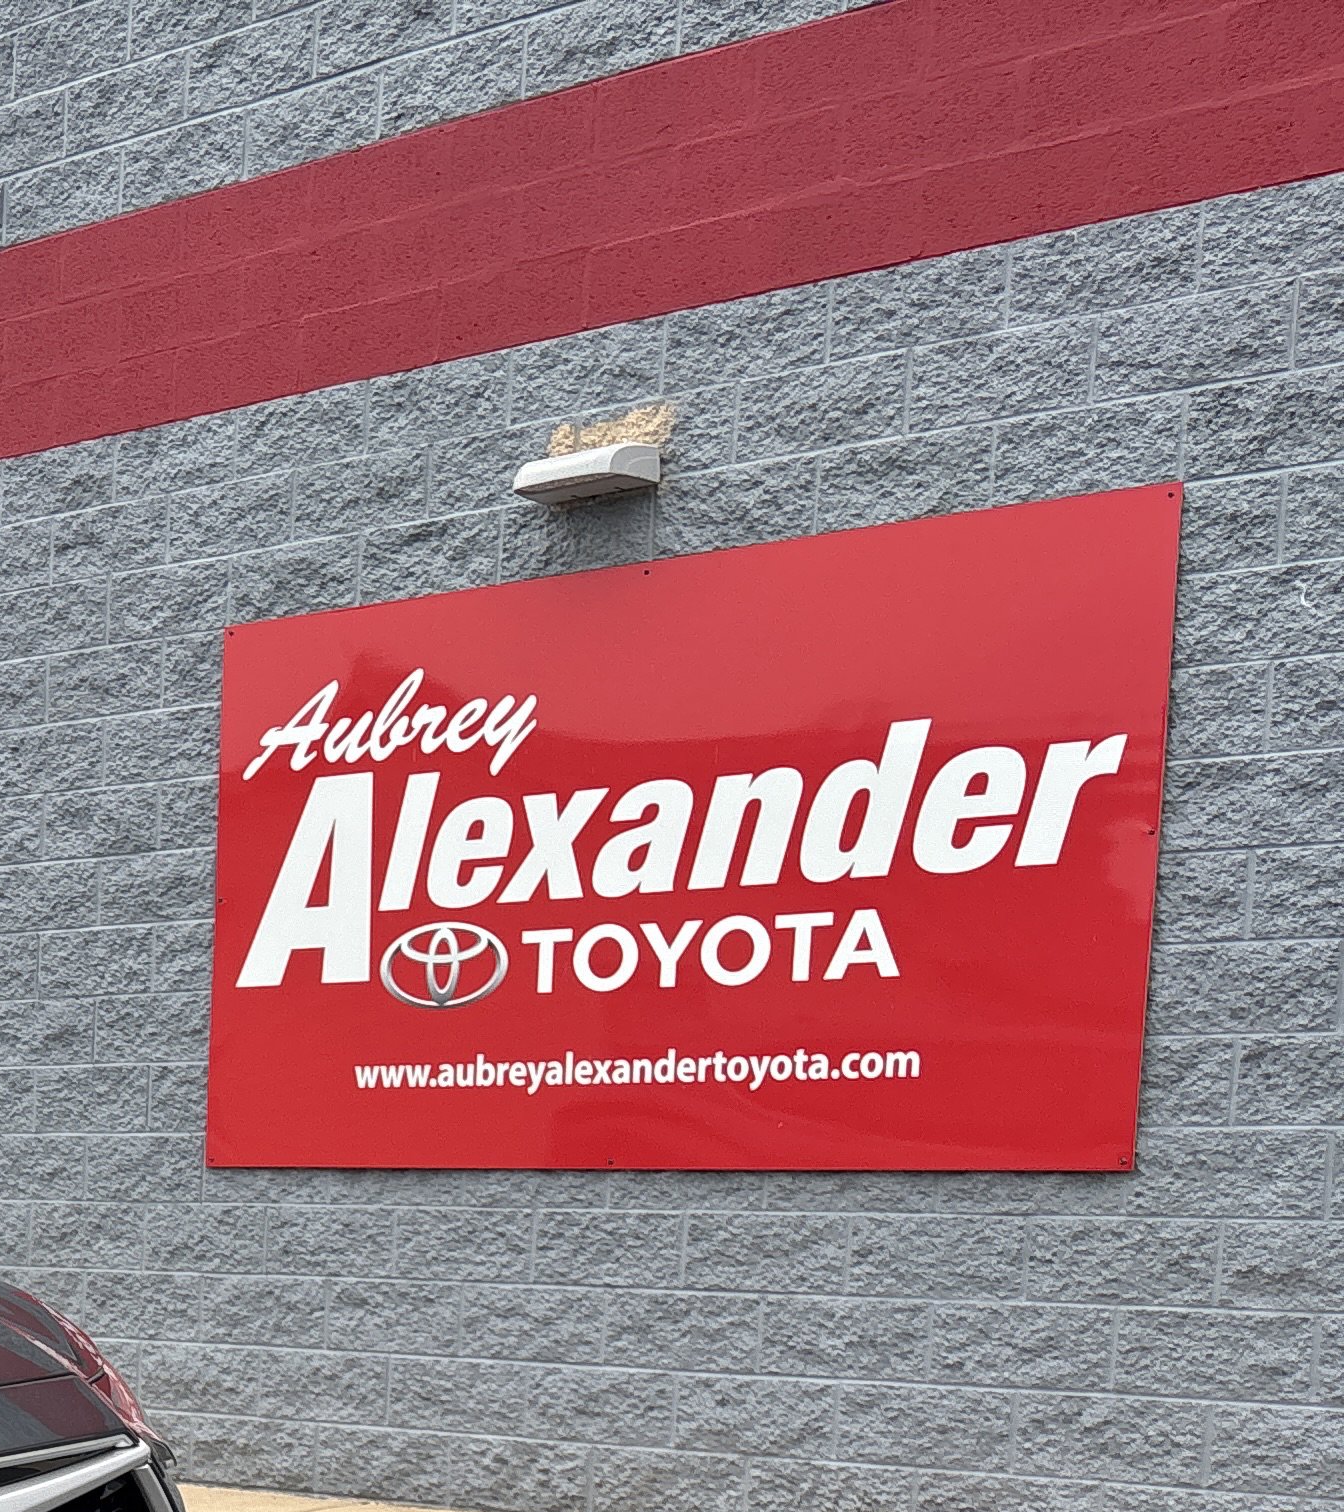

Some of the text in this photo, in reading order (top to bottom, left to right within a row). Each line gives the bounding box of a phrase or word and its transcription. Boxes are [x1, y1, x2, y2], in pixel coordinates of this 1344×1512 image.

[242, 667, 538, 781] Aubrey
[235, 718, 1128, 990] Alexander
[520, 908, 900, 994] TOYOTA
[354, 1048, 921, 1096] www.aubreyalexandertoyota.com
